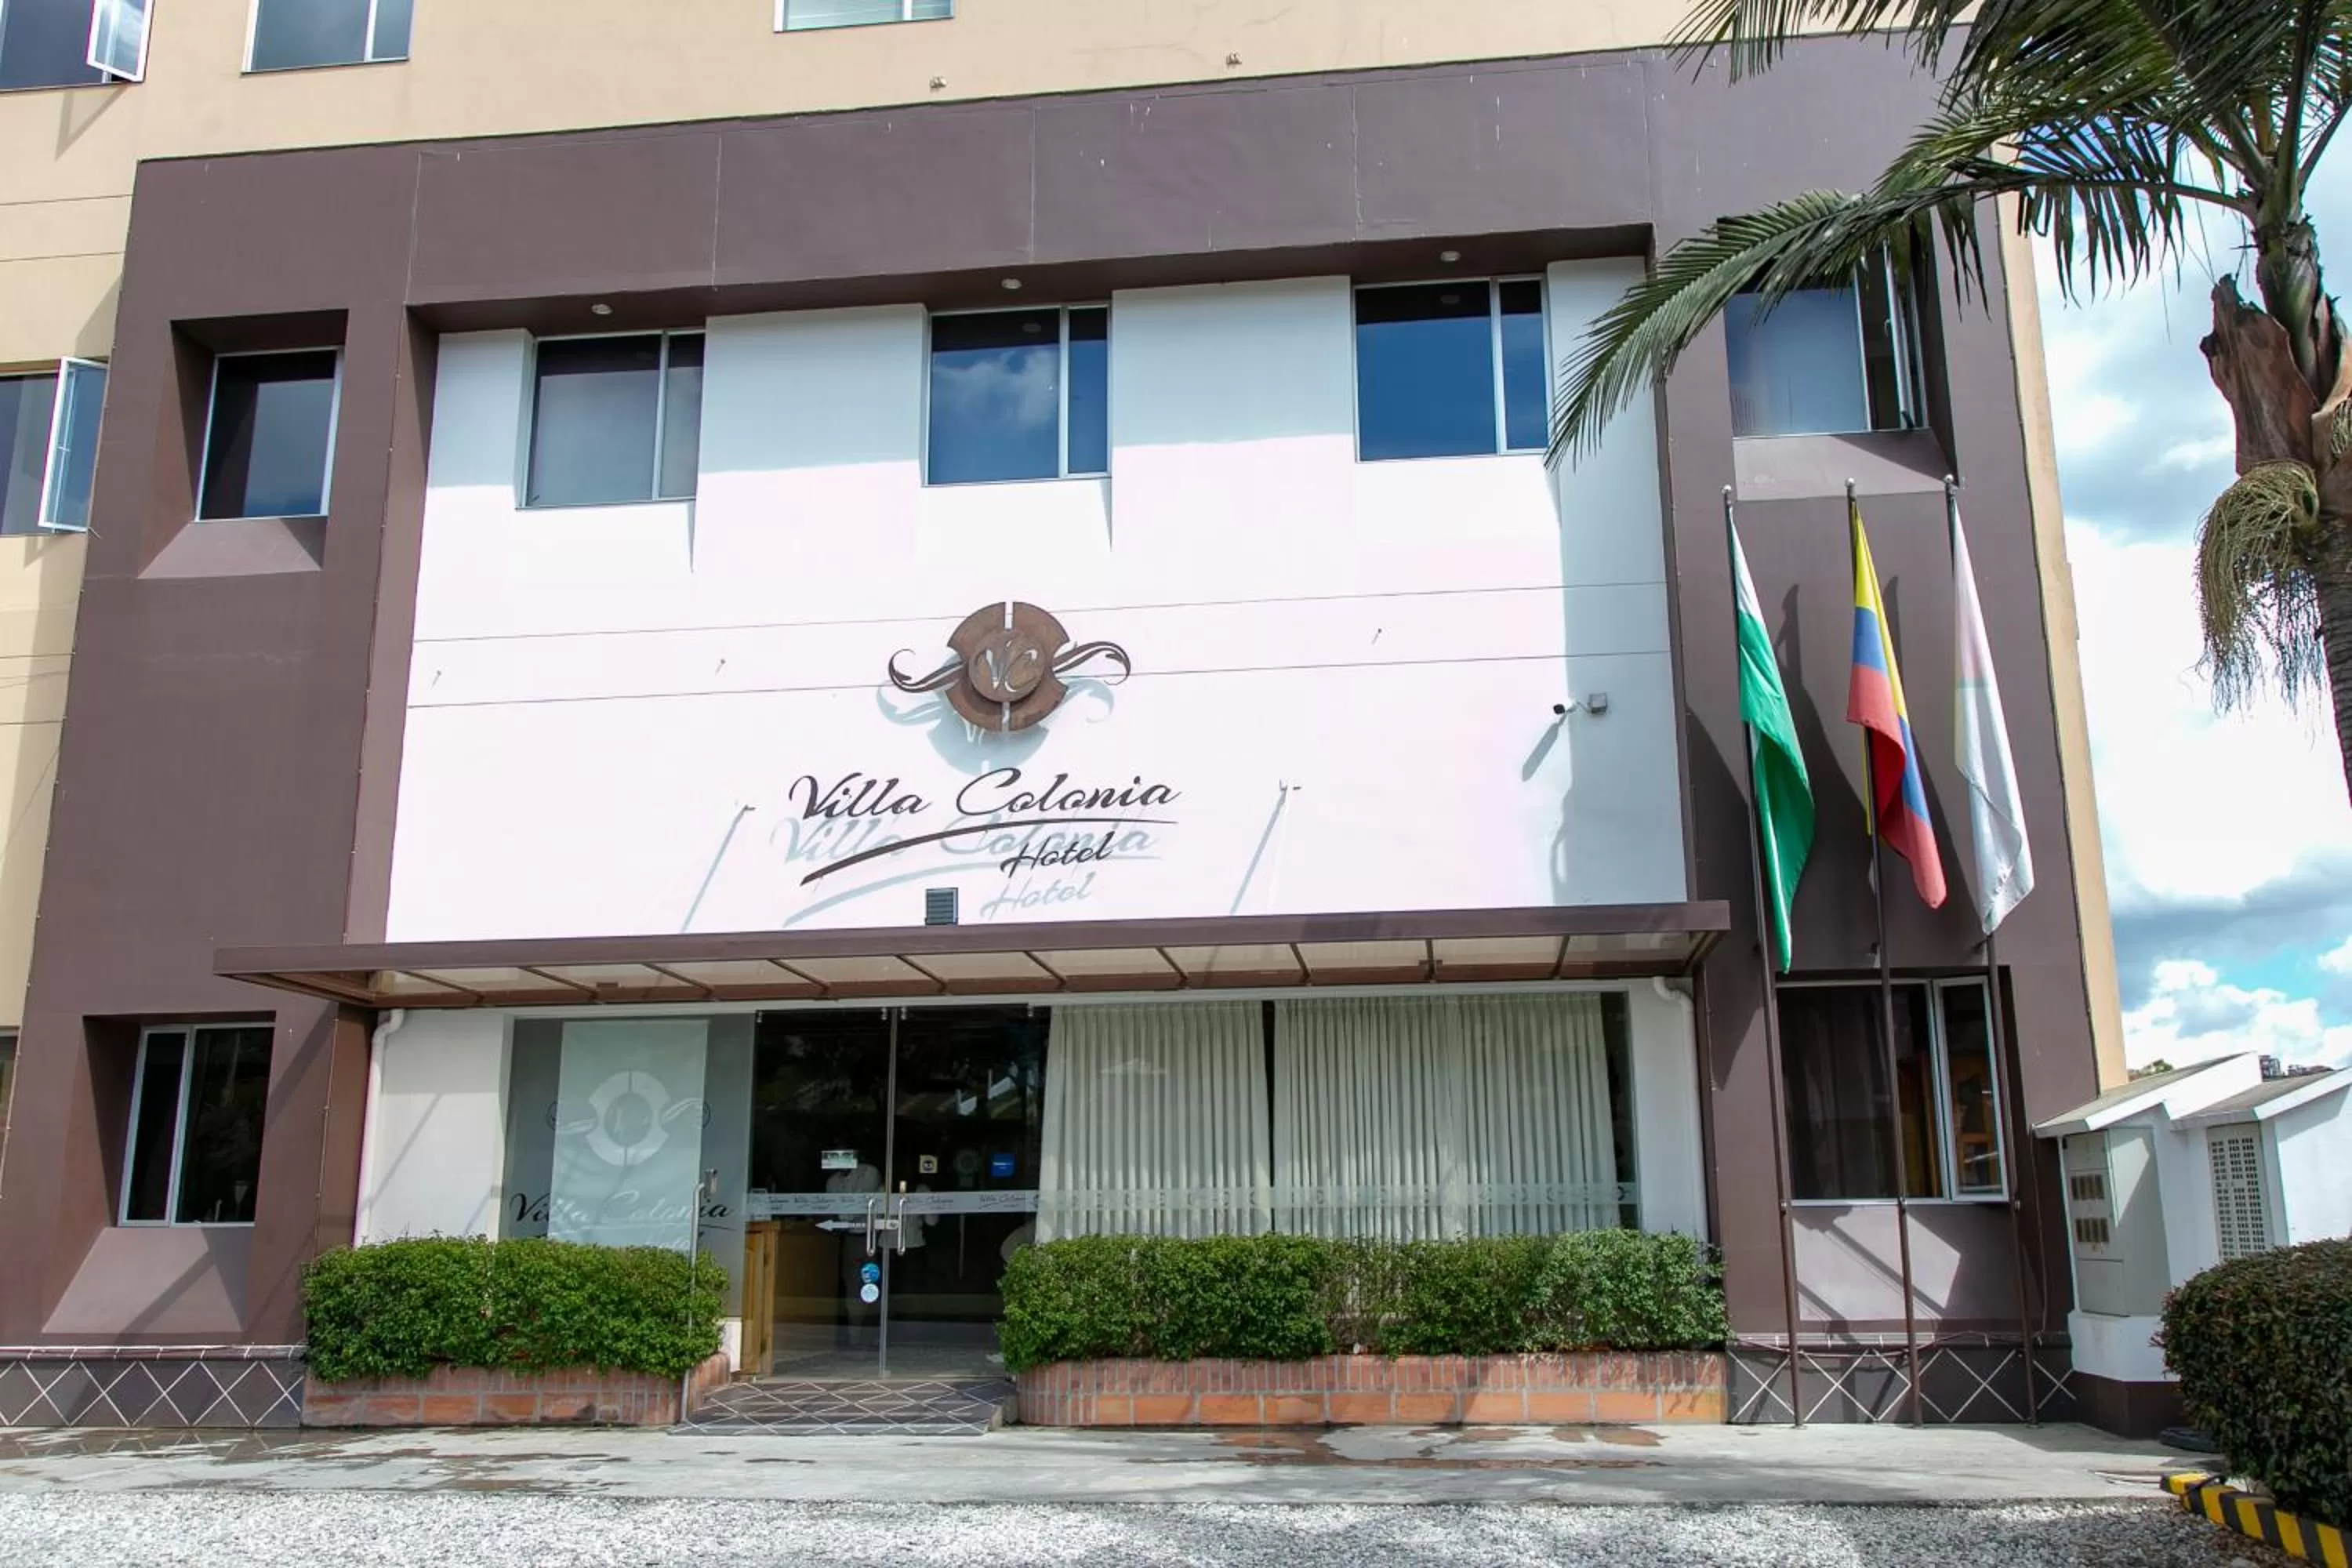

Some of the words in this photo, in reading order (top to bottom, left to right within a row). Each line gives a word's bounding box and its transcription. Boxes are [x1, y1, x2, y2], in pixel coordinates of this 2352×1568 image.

[789, 772, 931, 818] Villa
[956, 768, 1181, 816] Colonia
[1000, 832, 1116, 878] Hotel
